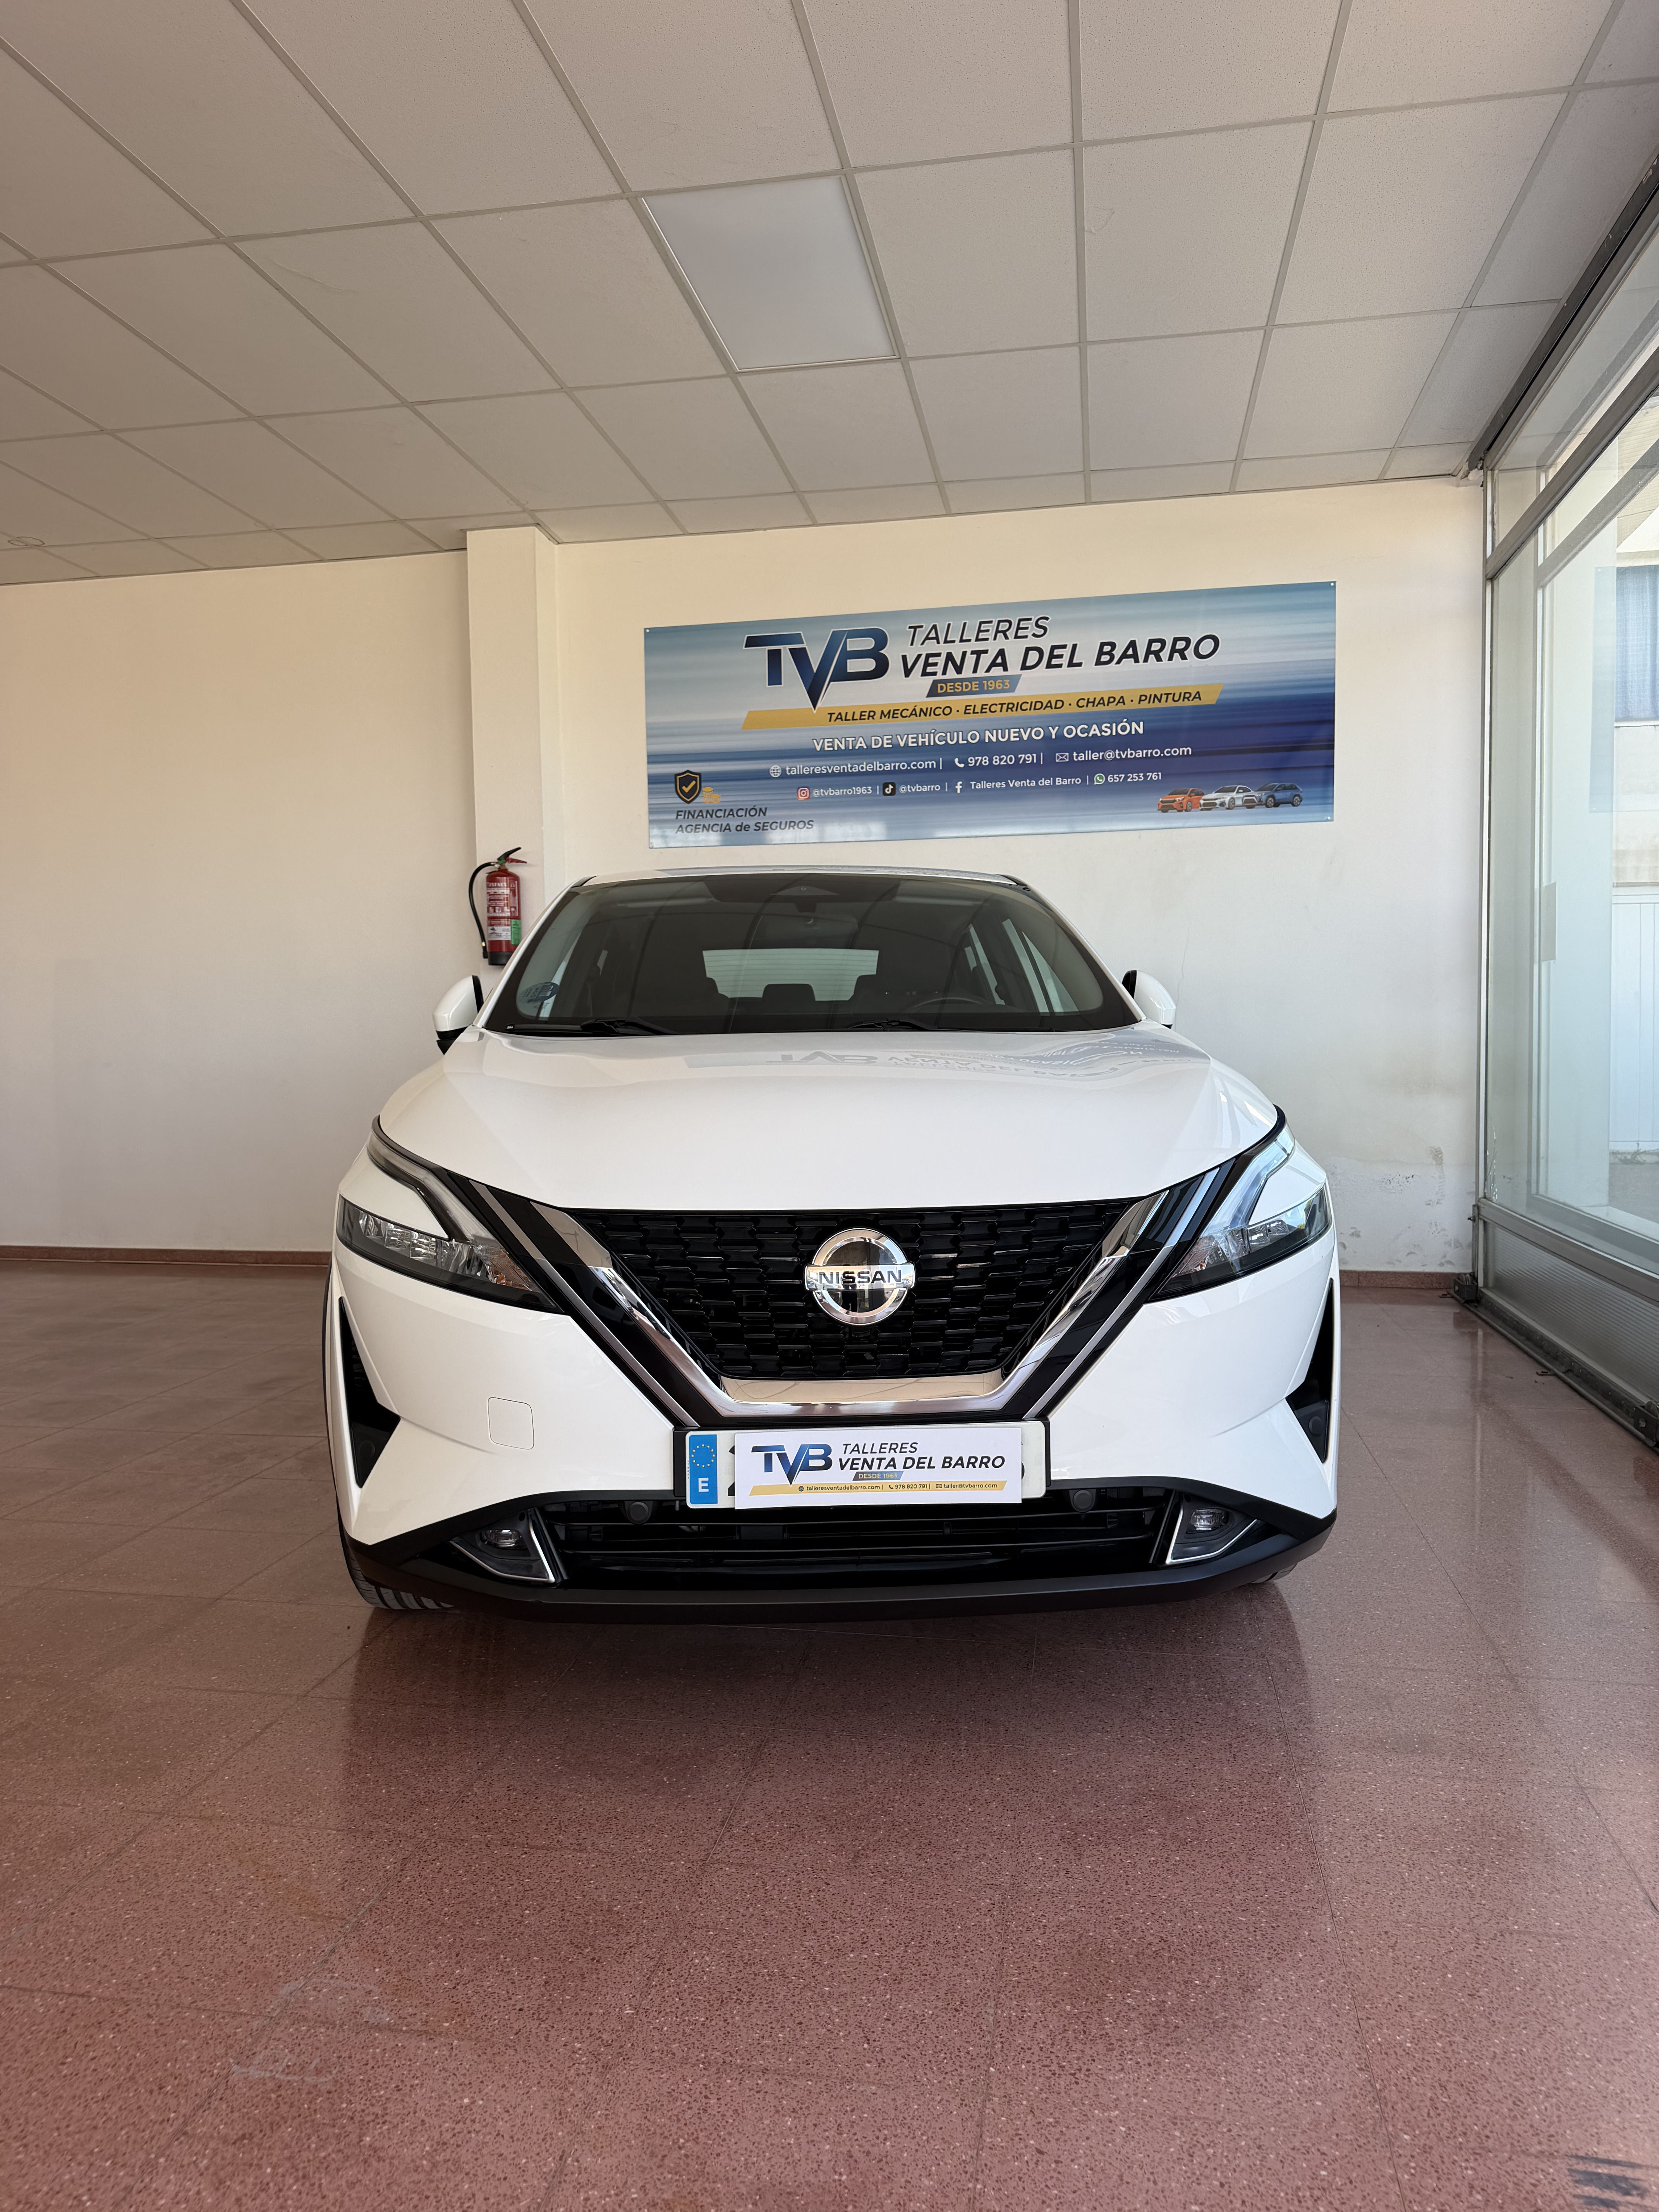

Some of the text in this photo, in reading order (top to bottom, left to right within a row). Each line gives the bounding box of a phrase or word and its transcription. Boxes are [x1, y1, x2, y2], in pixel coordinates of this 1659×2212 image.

[907, 616, 1050, 646] TALLERES
[901, 634, 1220, 678] VENTA DEL BARRO
[744, 627, 890, 713] TVB
[937, 679, 1010, 694] DESDE 1963
[827, 690, 1202, 722] TALLER MECÁNICO ELECTRICIDAD CHAPA PINTURA
[813, 718, 1144, 751] VENTA DE VEHÍCULO NUEVO Y OCASIÓN
[786, 746, 1192, 775] talleresventadelbarro.com 978 820 791 taller@tvbarro.com
[812, 772, 1162, 797] @tvbarro1963 @tvbarro Talleres Venta del Barro 657 253 761
[676, 805, 767, 820] FINANCIACIÓN
[675, 820, 814, 834] AGENCIA de SEGUROS
[819, 1270, 902, 1284] NISSAN
[843, 1442, 918, 1455] TALLERES
[751, 1444, 833, 1486] TVB
[839, 1455, 1006, 1470] VENTA DEL BARRO
[698, 1477, 709, 1492] E
